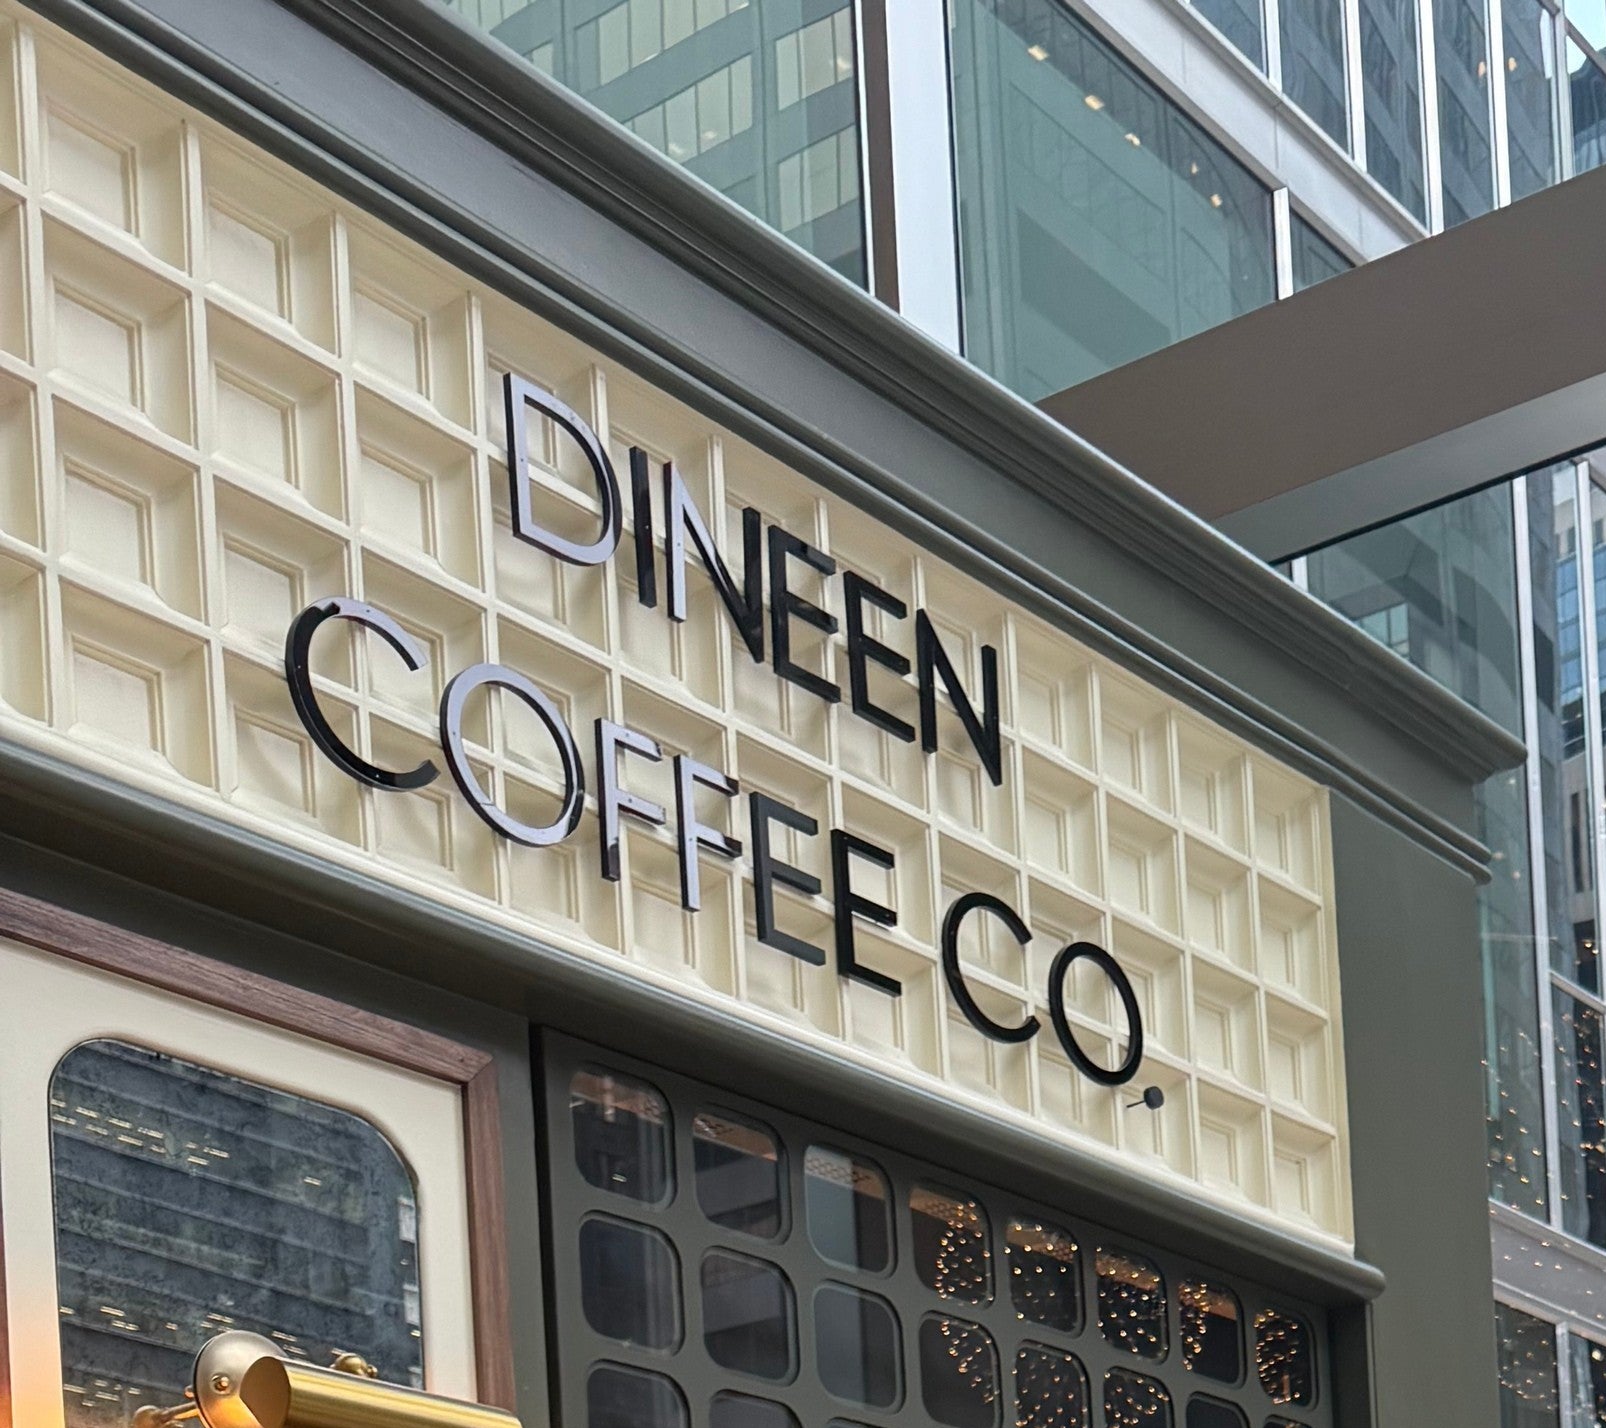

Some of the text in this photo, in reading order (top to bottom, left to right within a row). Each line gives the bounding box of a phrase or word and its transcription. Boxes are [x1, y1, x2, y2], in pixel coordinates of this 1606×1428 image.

[502, 371, 1003, 787] DINEEN
[284, 594, 1165, 1109] COFFEE CO.
